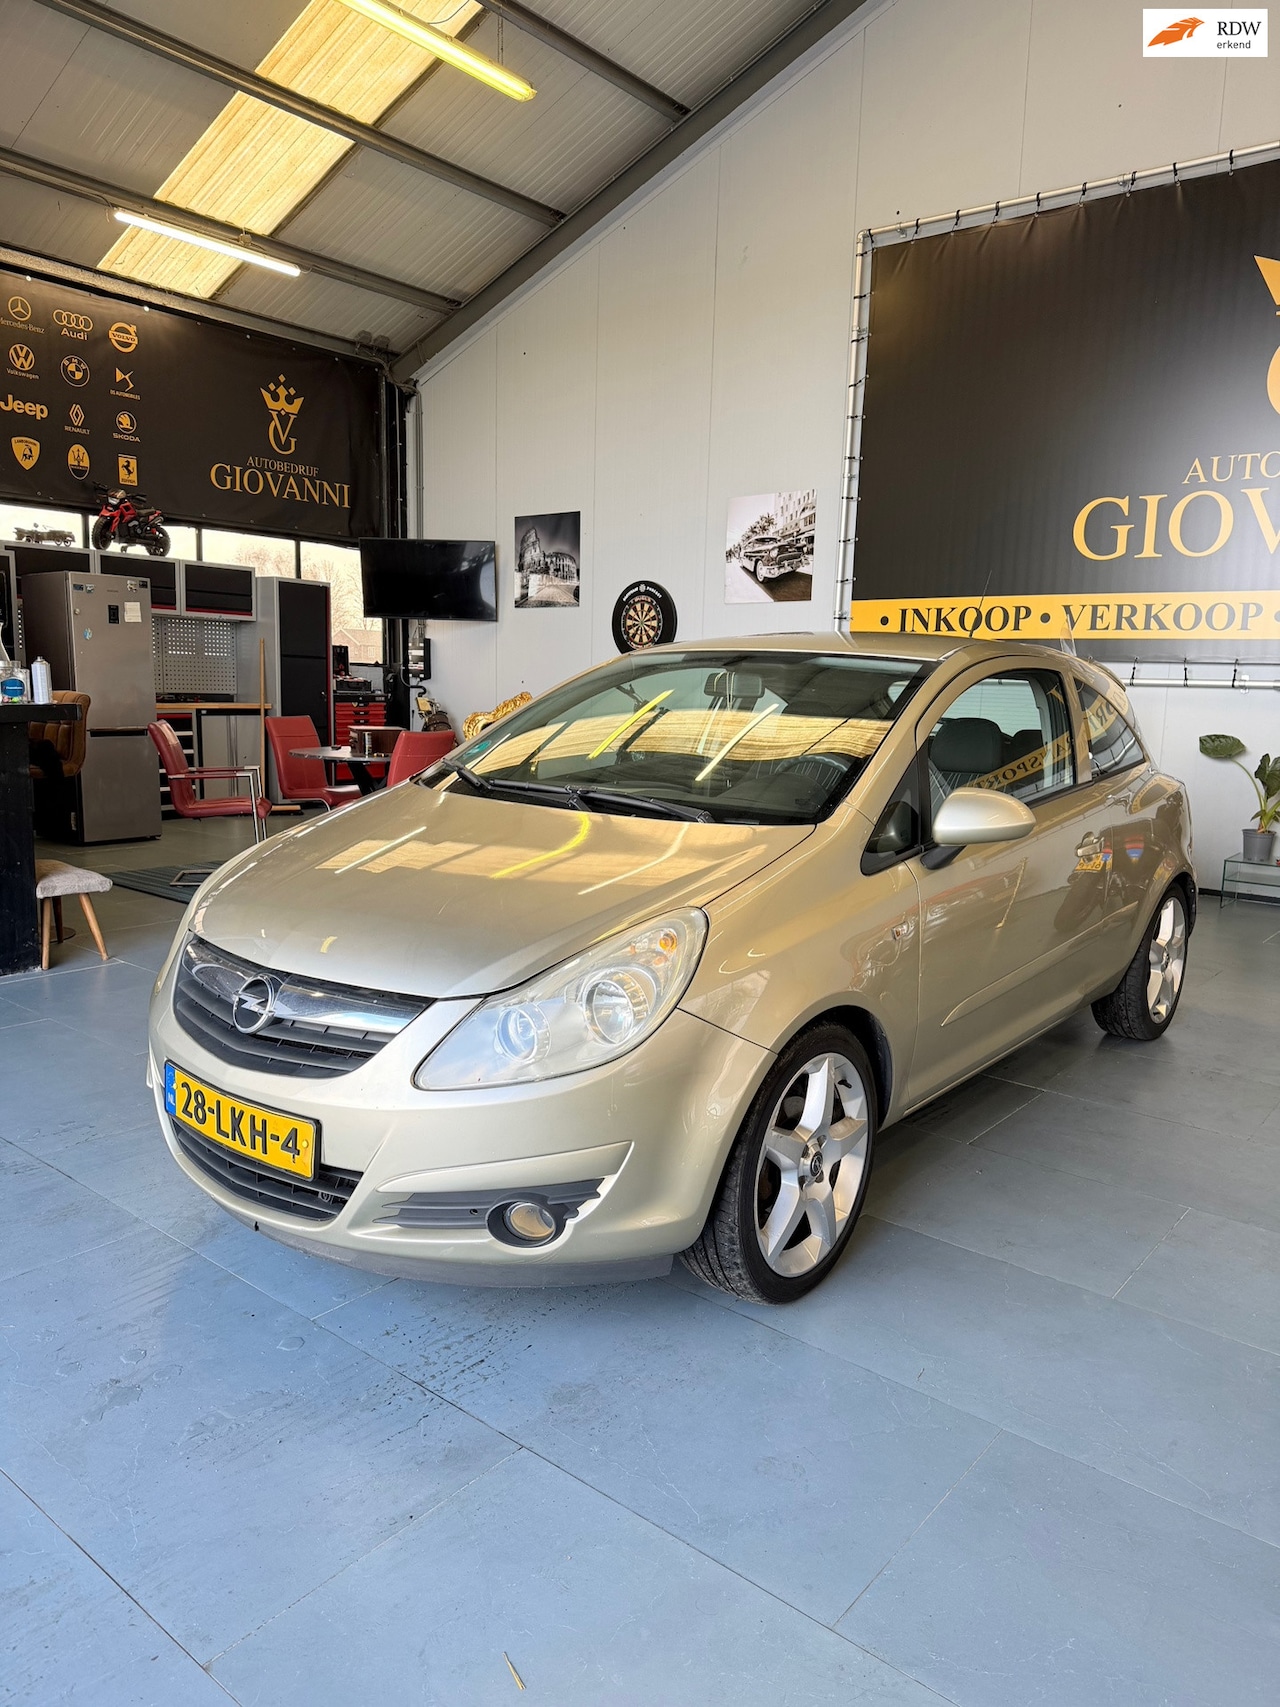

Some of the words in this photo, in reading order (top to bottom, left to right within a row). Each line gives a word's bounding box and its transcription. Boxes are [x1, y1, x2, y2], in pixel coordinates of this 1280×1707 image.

[61, 327, 88, 341] Audi
[111, 332, 136, 342] VOLVO
[6, 367, 40, 380] Volkswagen
[0, 394, 49, 420] Jeep
[64, 425, 90, 435] RENAULT
[246, 456, 320, 478] AUTOBEDRIJF
[210, 463, 351, 509] GIOVANNI
[899, 605, 1032, 633] INKOOP
[1061, 602, 1264, 632] VERKOOP
[181, 1081, 301, 1165] 28-LKH-4
